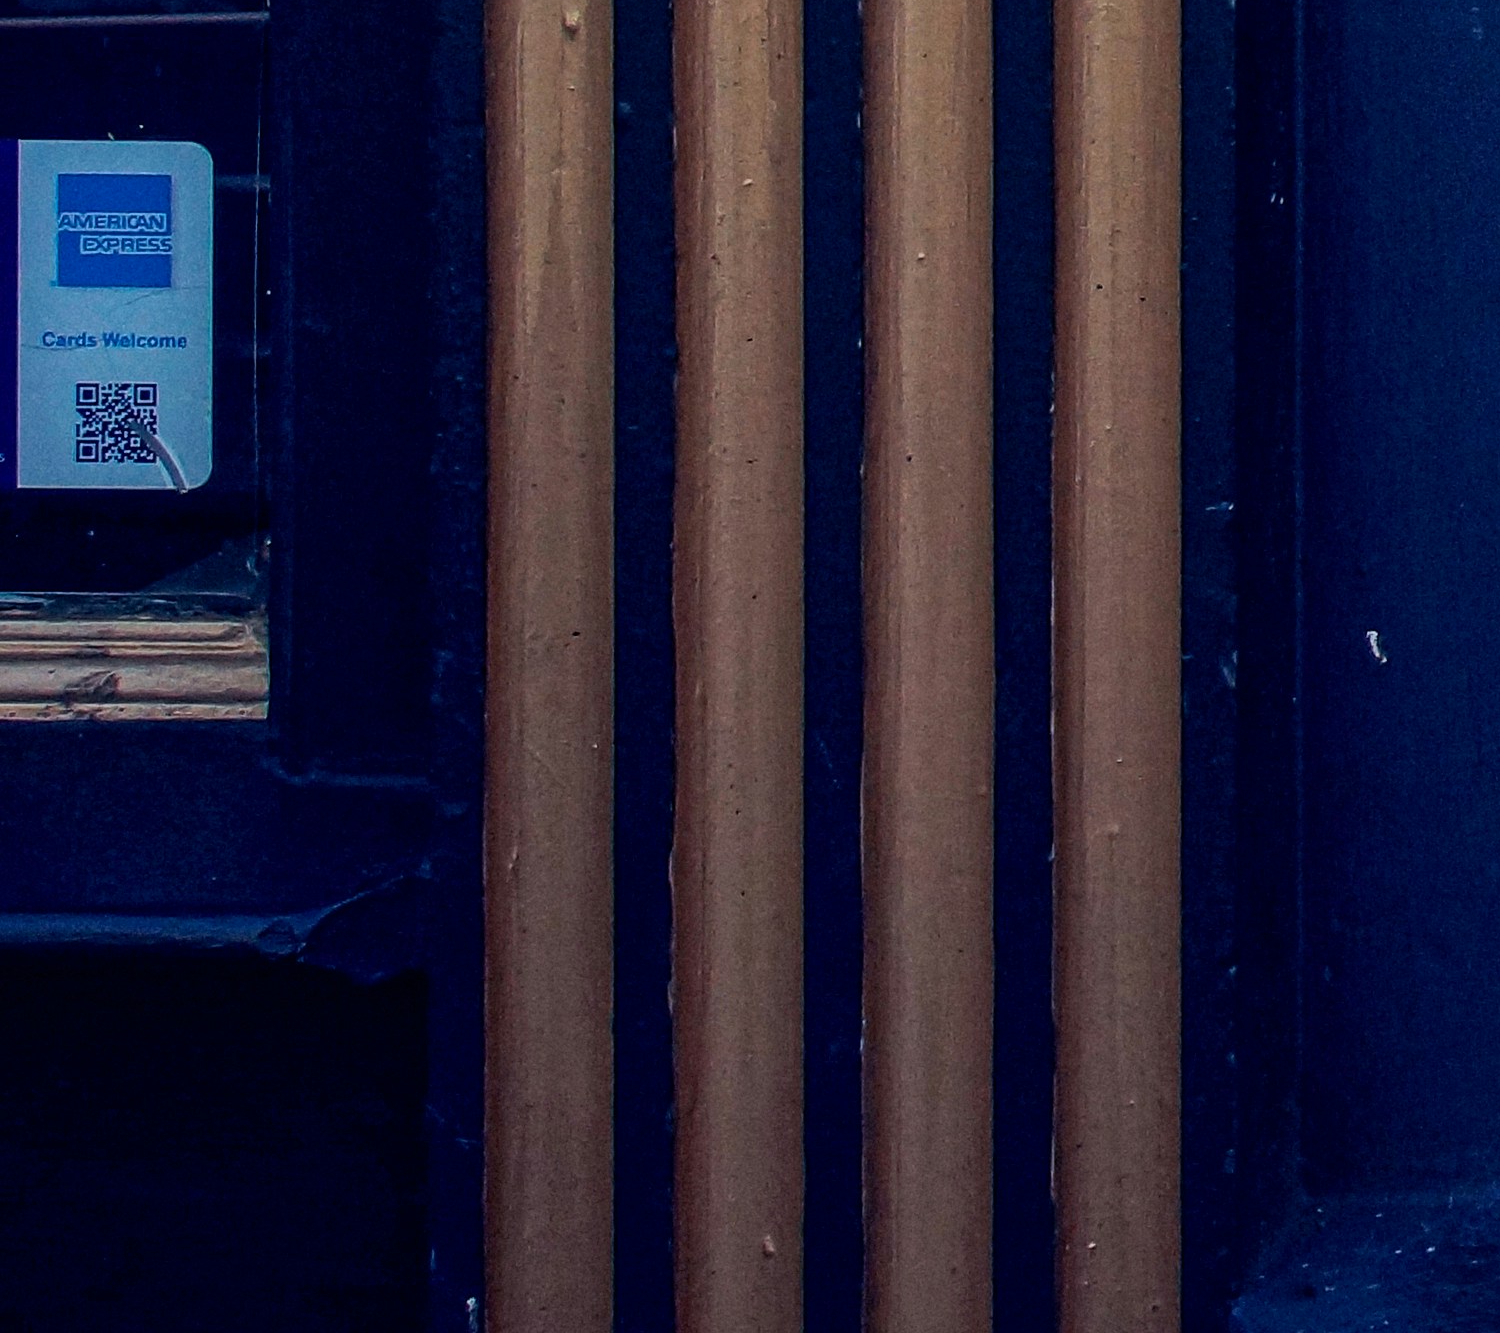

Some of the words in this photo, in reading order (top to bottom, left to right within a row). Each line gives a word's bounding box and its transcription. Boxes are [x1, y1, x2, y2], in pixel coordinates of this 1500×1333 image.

[58, 212, 167, 232] AMERICAN
[80, 235, 173, 255] EXPRESS
[42, 330, 97, 349] Cards
[102, 330, 188, 350] Welcome
